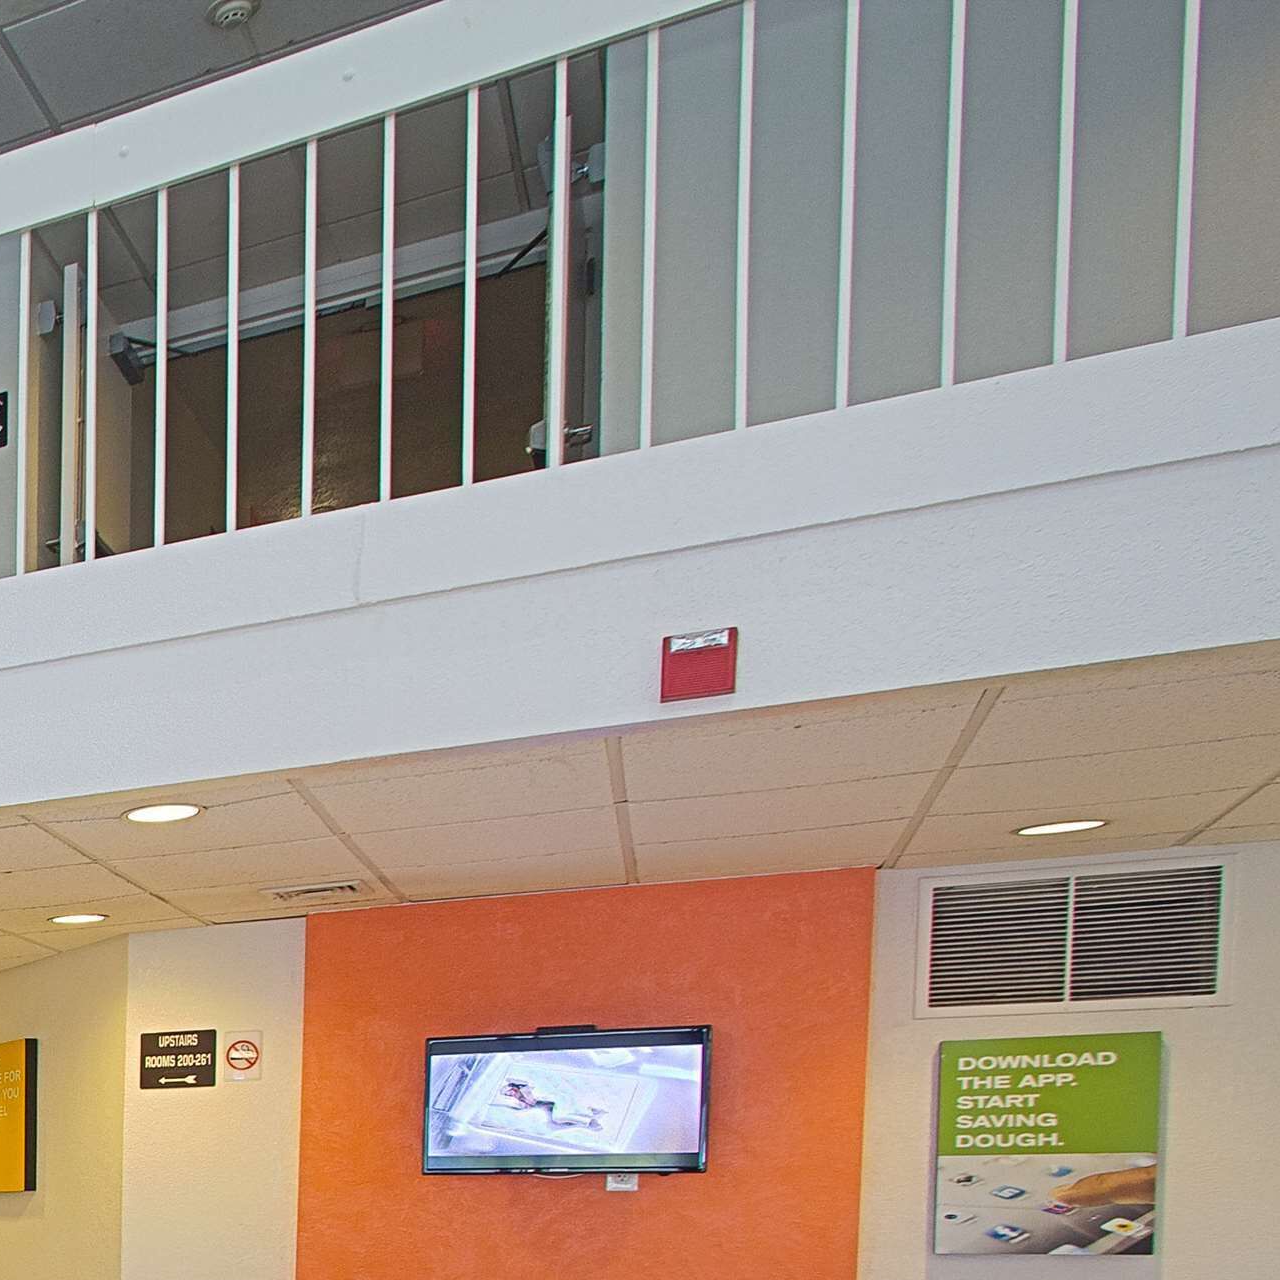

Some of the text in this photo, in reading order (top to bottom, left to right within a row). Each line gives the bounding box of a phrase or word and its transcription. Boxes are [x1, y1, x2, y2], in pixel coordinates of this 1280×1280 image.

[158, 1034, 198, 1048] UPSTAIRS
[145, 1053, 212, 1069] ROOMS 200-261
[958, 1051, 1118, 1072] DOWNLOAD
[4, 1070, 21, 1083] FOR
[956, 1073, 1078, 1090] THE APP.
[2, 1087, 19, 1100] YOU
[956, 1093, 1041, 1110] START
[955, 1112, 1058, 1130] SAVING
[955, 1132, 1065, 1149] DOUGH.
